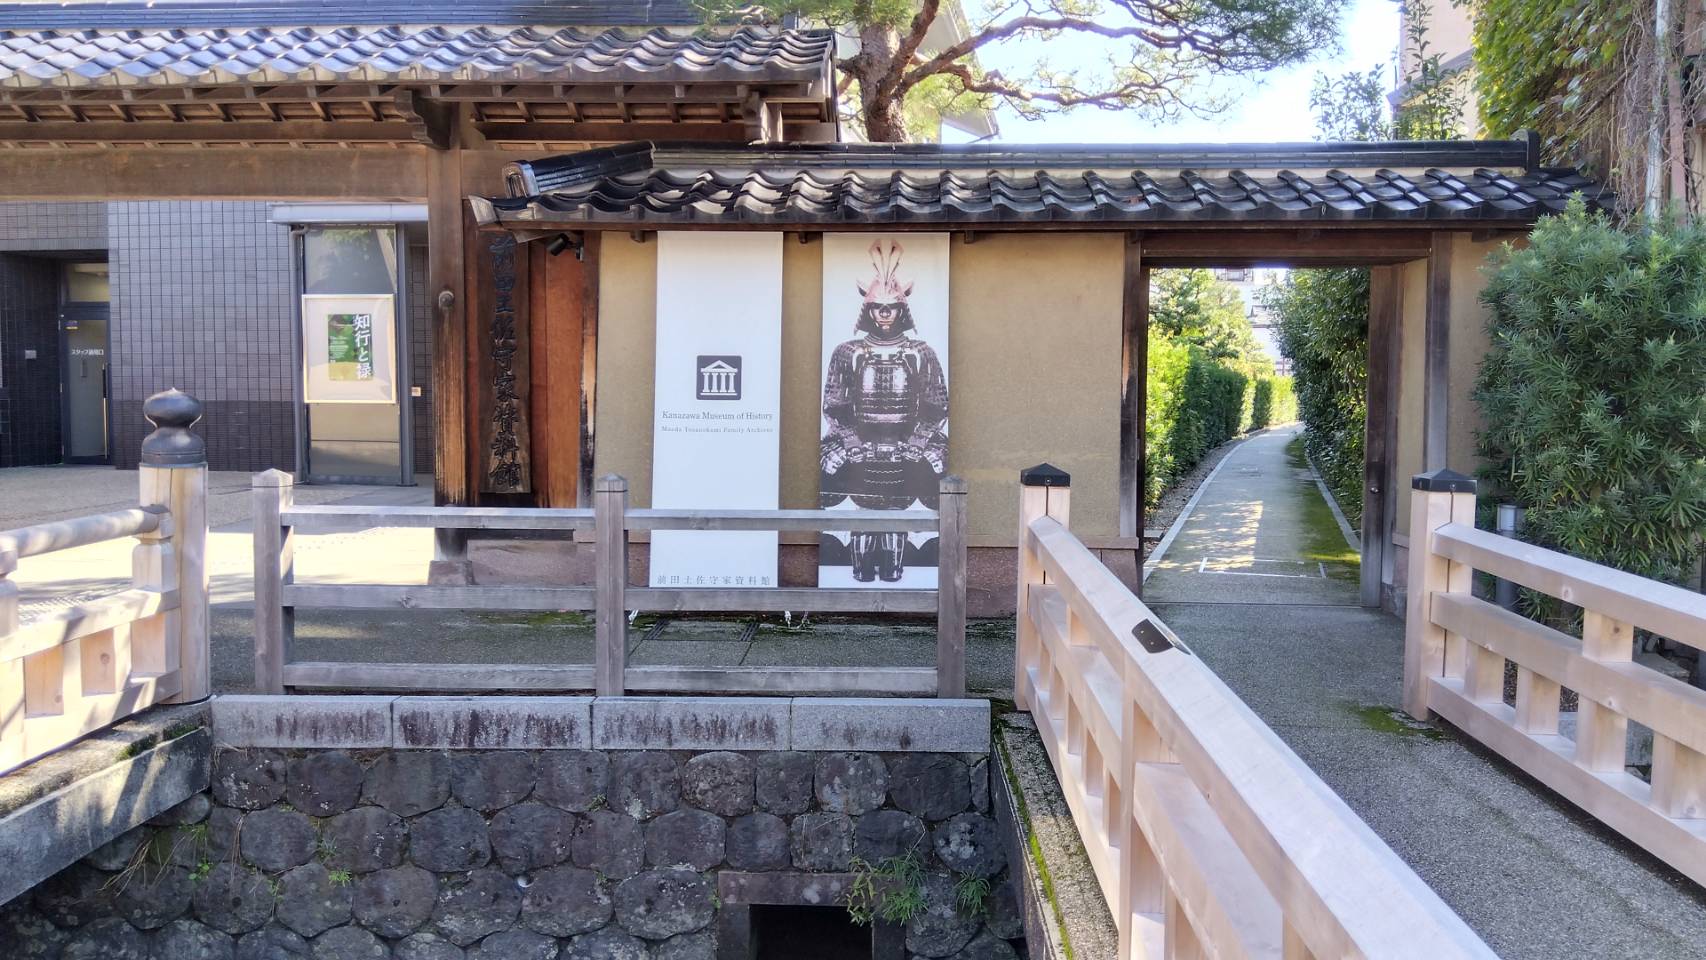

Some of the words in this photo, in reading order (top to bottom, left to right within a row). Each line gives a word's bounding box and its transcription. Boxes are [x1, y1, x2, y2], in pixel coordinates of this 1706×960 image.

[662, 410, 700, 419] Kanazawa
[702, 411, 735, 420] Museum
[737, 411, 745, 420] of
[746, 411, 772, 421] History
